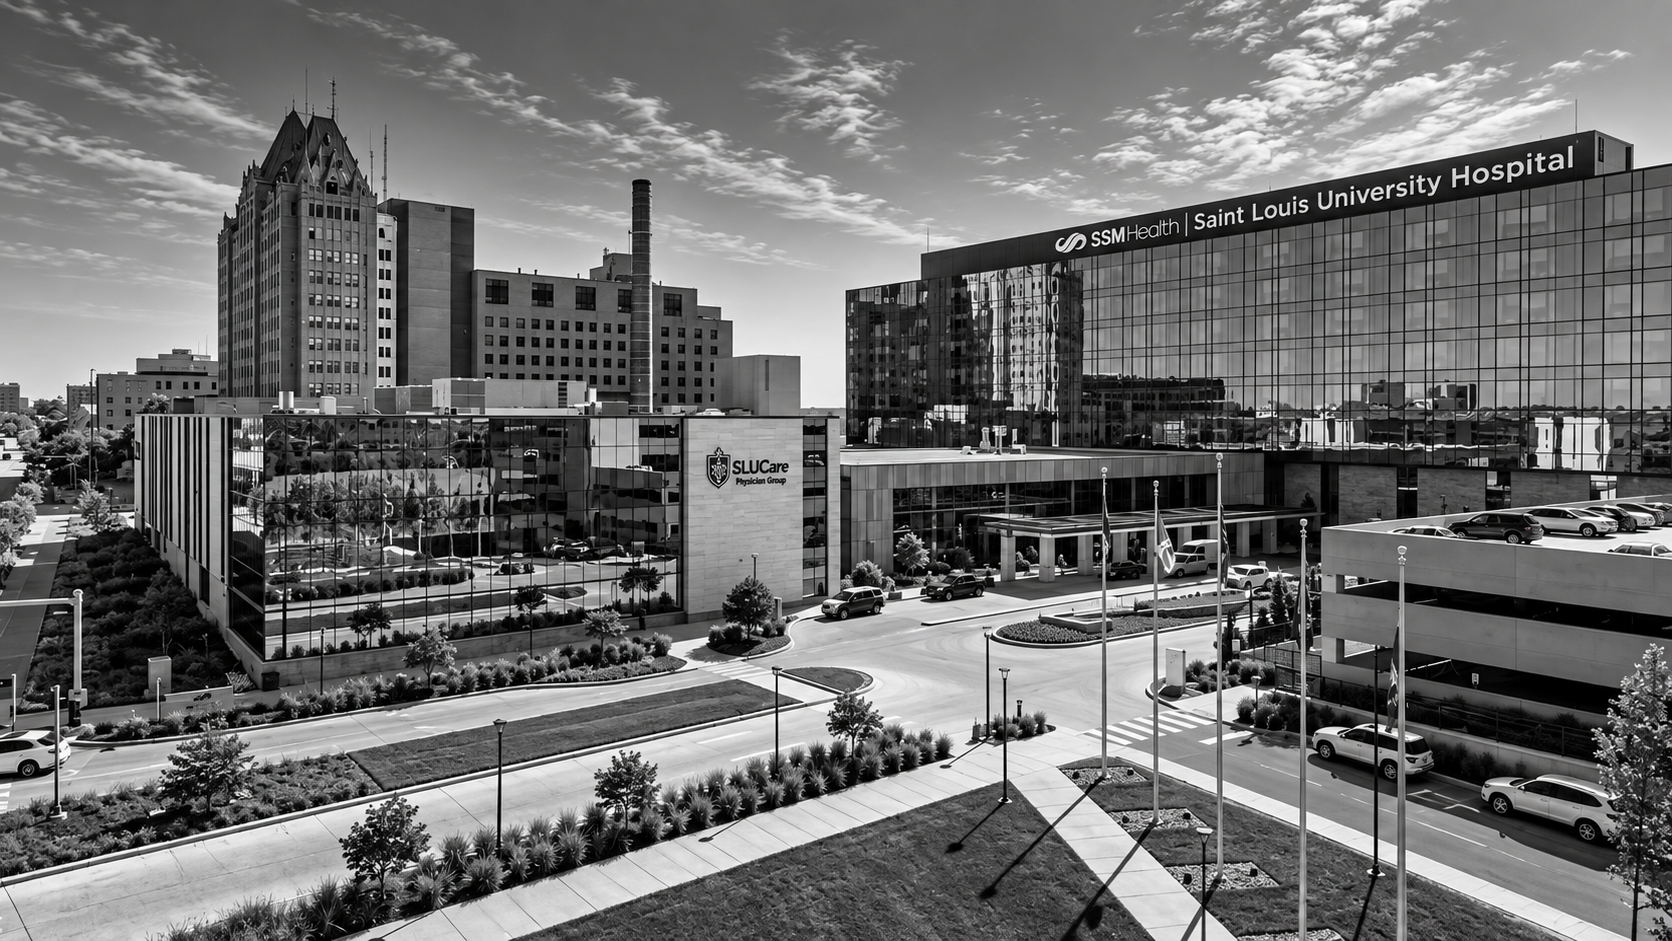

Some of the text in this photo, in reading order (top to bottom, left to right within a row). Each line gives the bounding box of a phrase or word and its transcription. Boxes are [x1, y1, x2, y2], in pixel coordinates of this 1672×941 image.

[1194, 207, 1245, 230] Saint
[1252, 196, 1309, 221] Louis
[1317, 174, 1442, 211] University
[1451, 145, 1574, 188] Hospital
[732, 459, 789, 475] SLUCare
[735, 476, 786, 487] Physician Group
